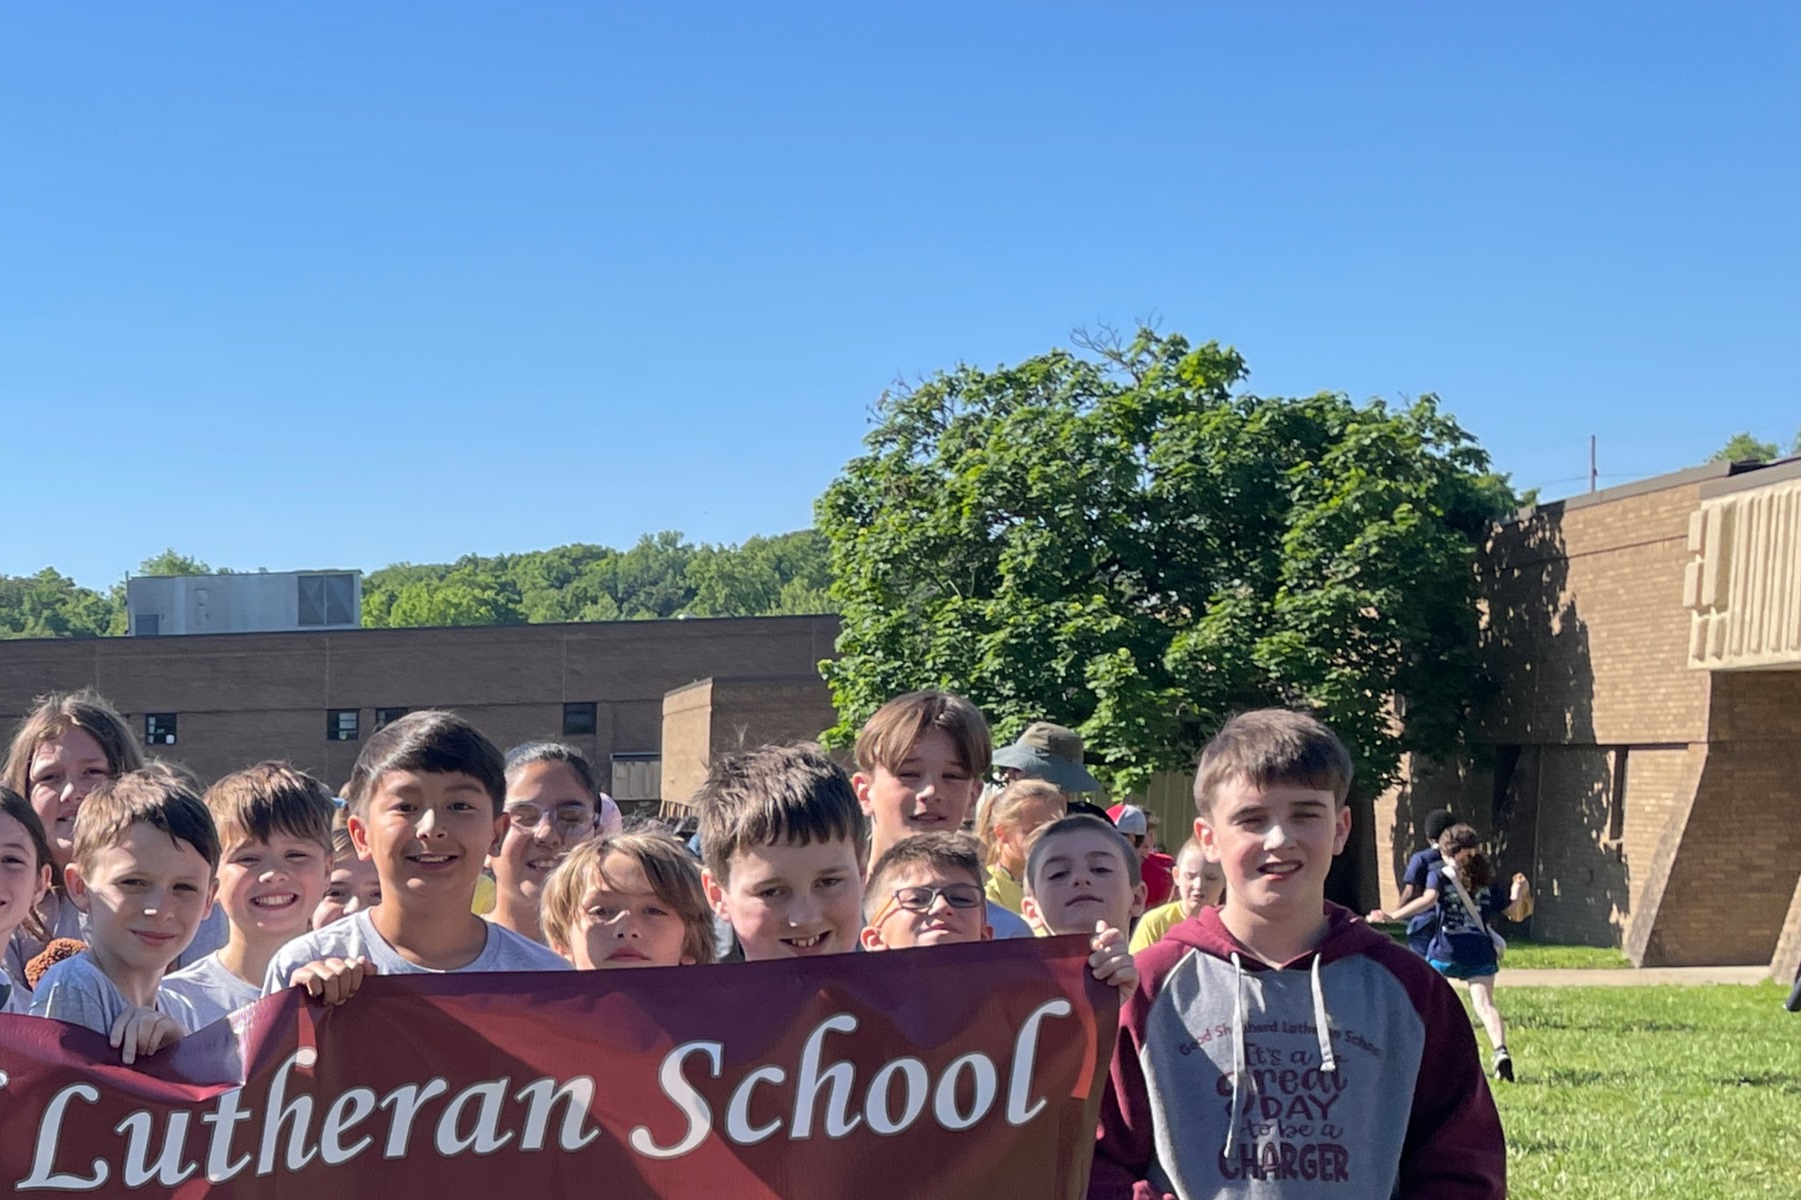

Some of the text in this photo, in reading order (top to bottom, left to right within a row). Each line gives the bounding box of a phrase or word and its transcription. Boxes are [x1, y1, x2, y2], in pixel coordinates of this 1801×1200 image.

[1215, 1020, 1277, 1038] Shherd
[1290, 1050, 1314, 1067] a
[16, 1047, 602, 1191] Lutheran
[629, 998, 1072, 1160] School
[1259, 1093, 1340, 1121] DAY
[1241, 1118, 1344, 1139] to be a
[1218, 1141, 1349, 1183] CHARGER
